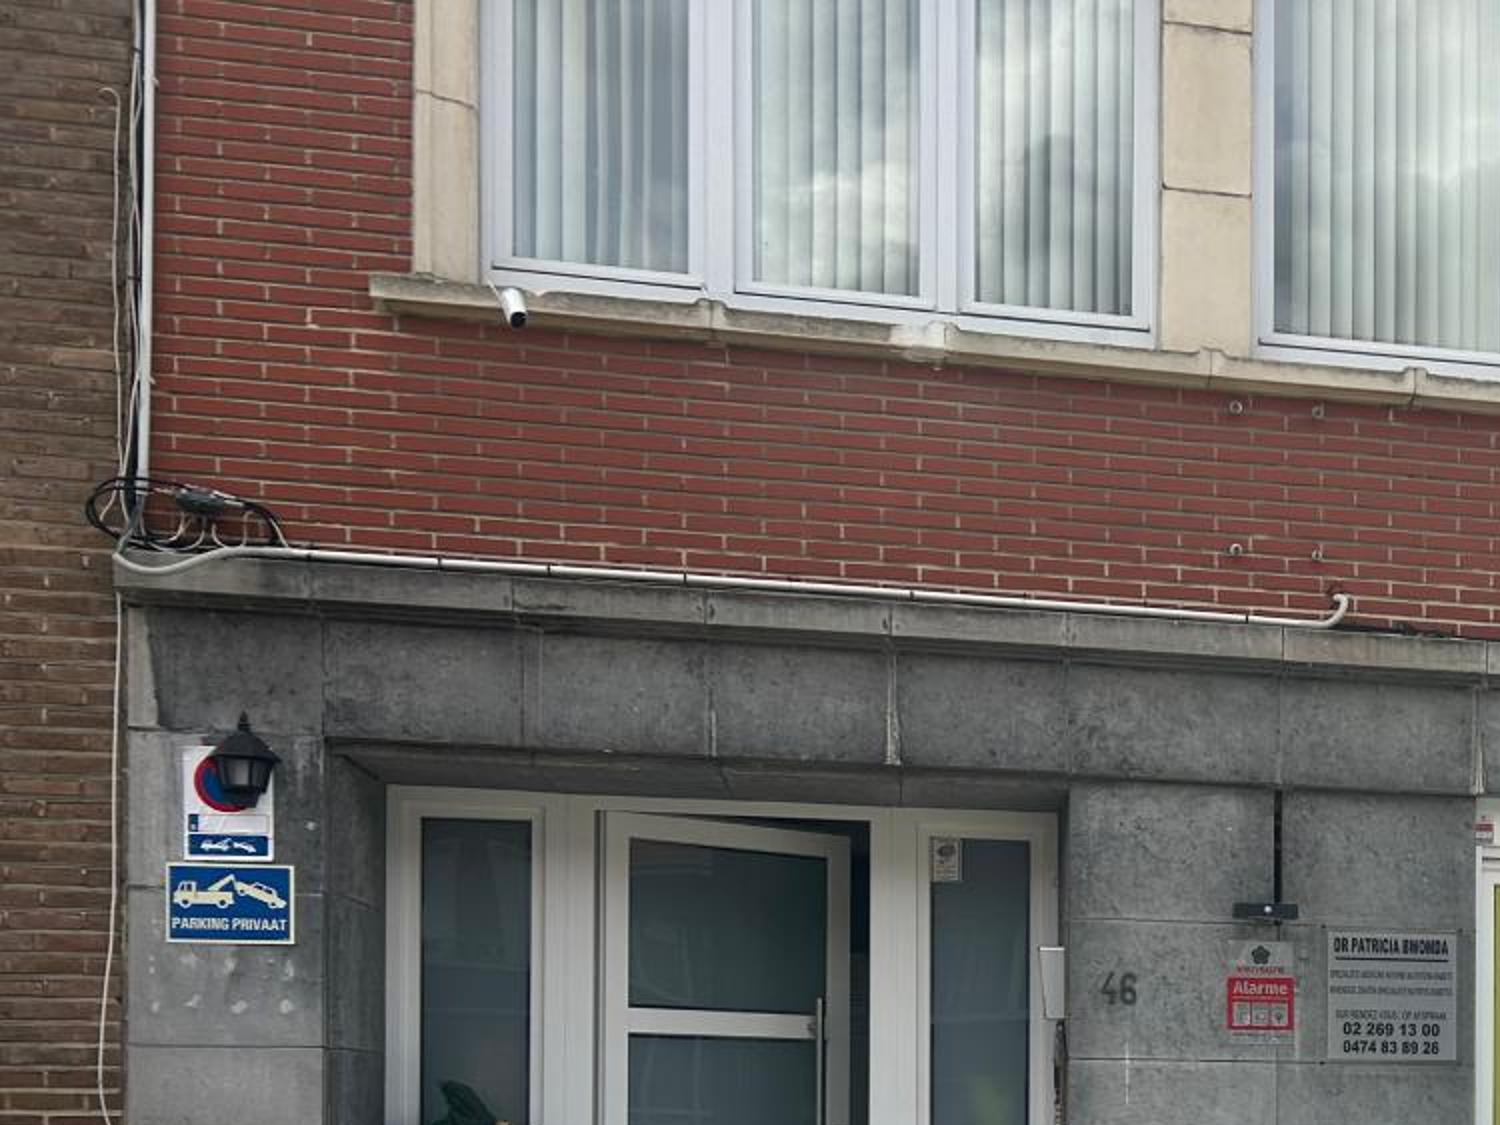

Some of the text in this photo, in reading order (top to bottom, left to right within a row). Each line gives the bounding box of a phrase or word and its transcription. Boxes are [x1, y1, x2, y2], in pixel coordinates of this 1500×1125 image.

[171, 917, 287, 931] PARKING PRIVAAT
[1333, 936, 1349, 953] DR
[1351, 937, 1399, 954] PATRICIA
[1101, 971, 1137, 1005] 46
[1232, 980, 1288, 995] Alarme
[1343, 1021, 1440, 1037] 02 269 13 00
[1343, 1040, 1376, 1054] 0474
